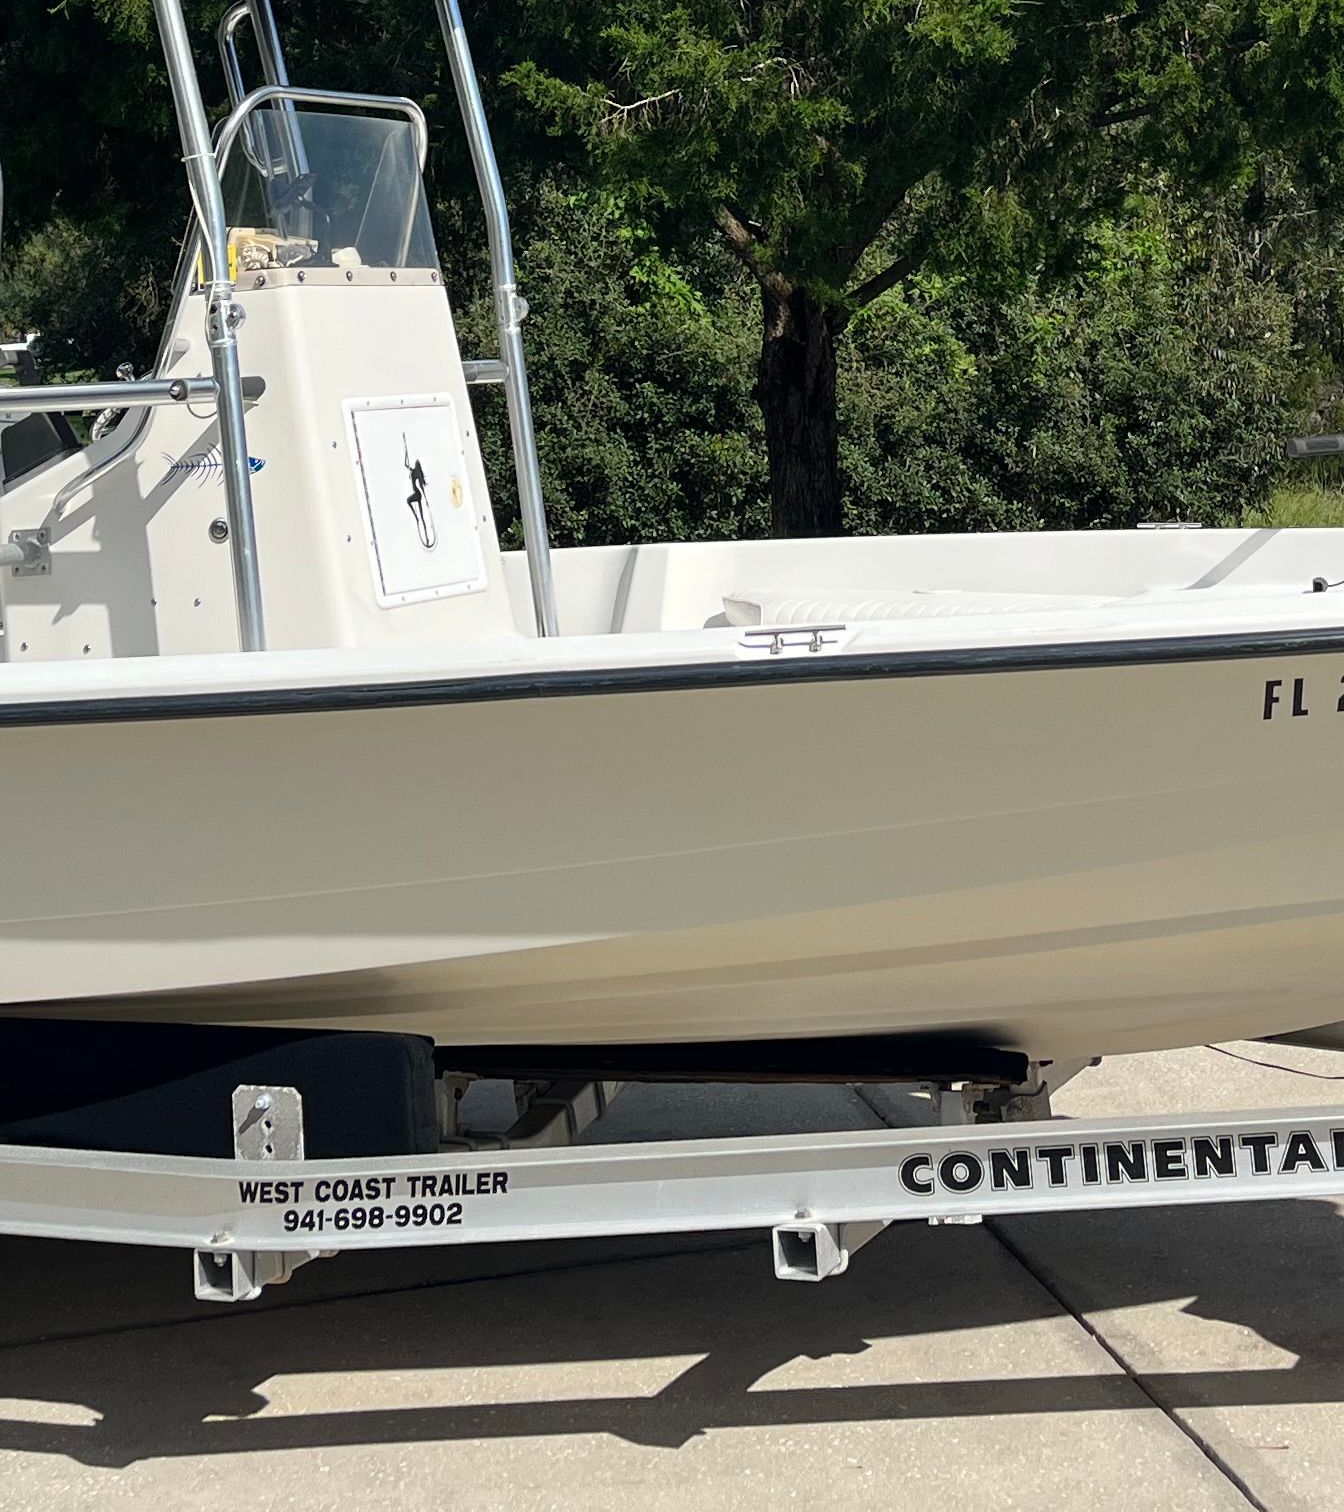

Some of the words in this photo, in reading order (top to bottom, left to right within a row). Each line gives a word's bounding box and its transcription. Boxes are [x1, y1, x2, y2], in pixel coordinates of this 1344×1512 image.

[1263, 678, 1309, 720] FL
[238, 1181, 304, 1204] WEST
[314, 1177, 396, 1203] COAST
[407, 1172, 509, 1198] TRAILER
[283, 1202, 463, 1232] 941-698-9902
